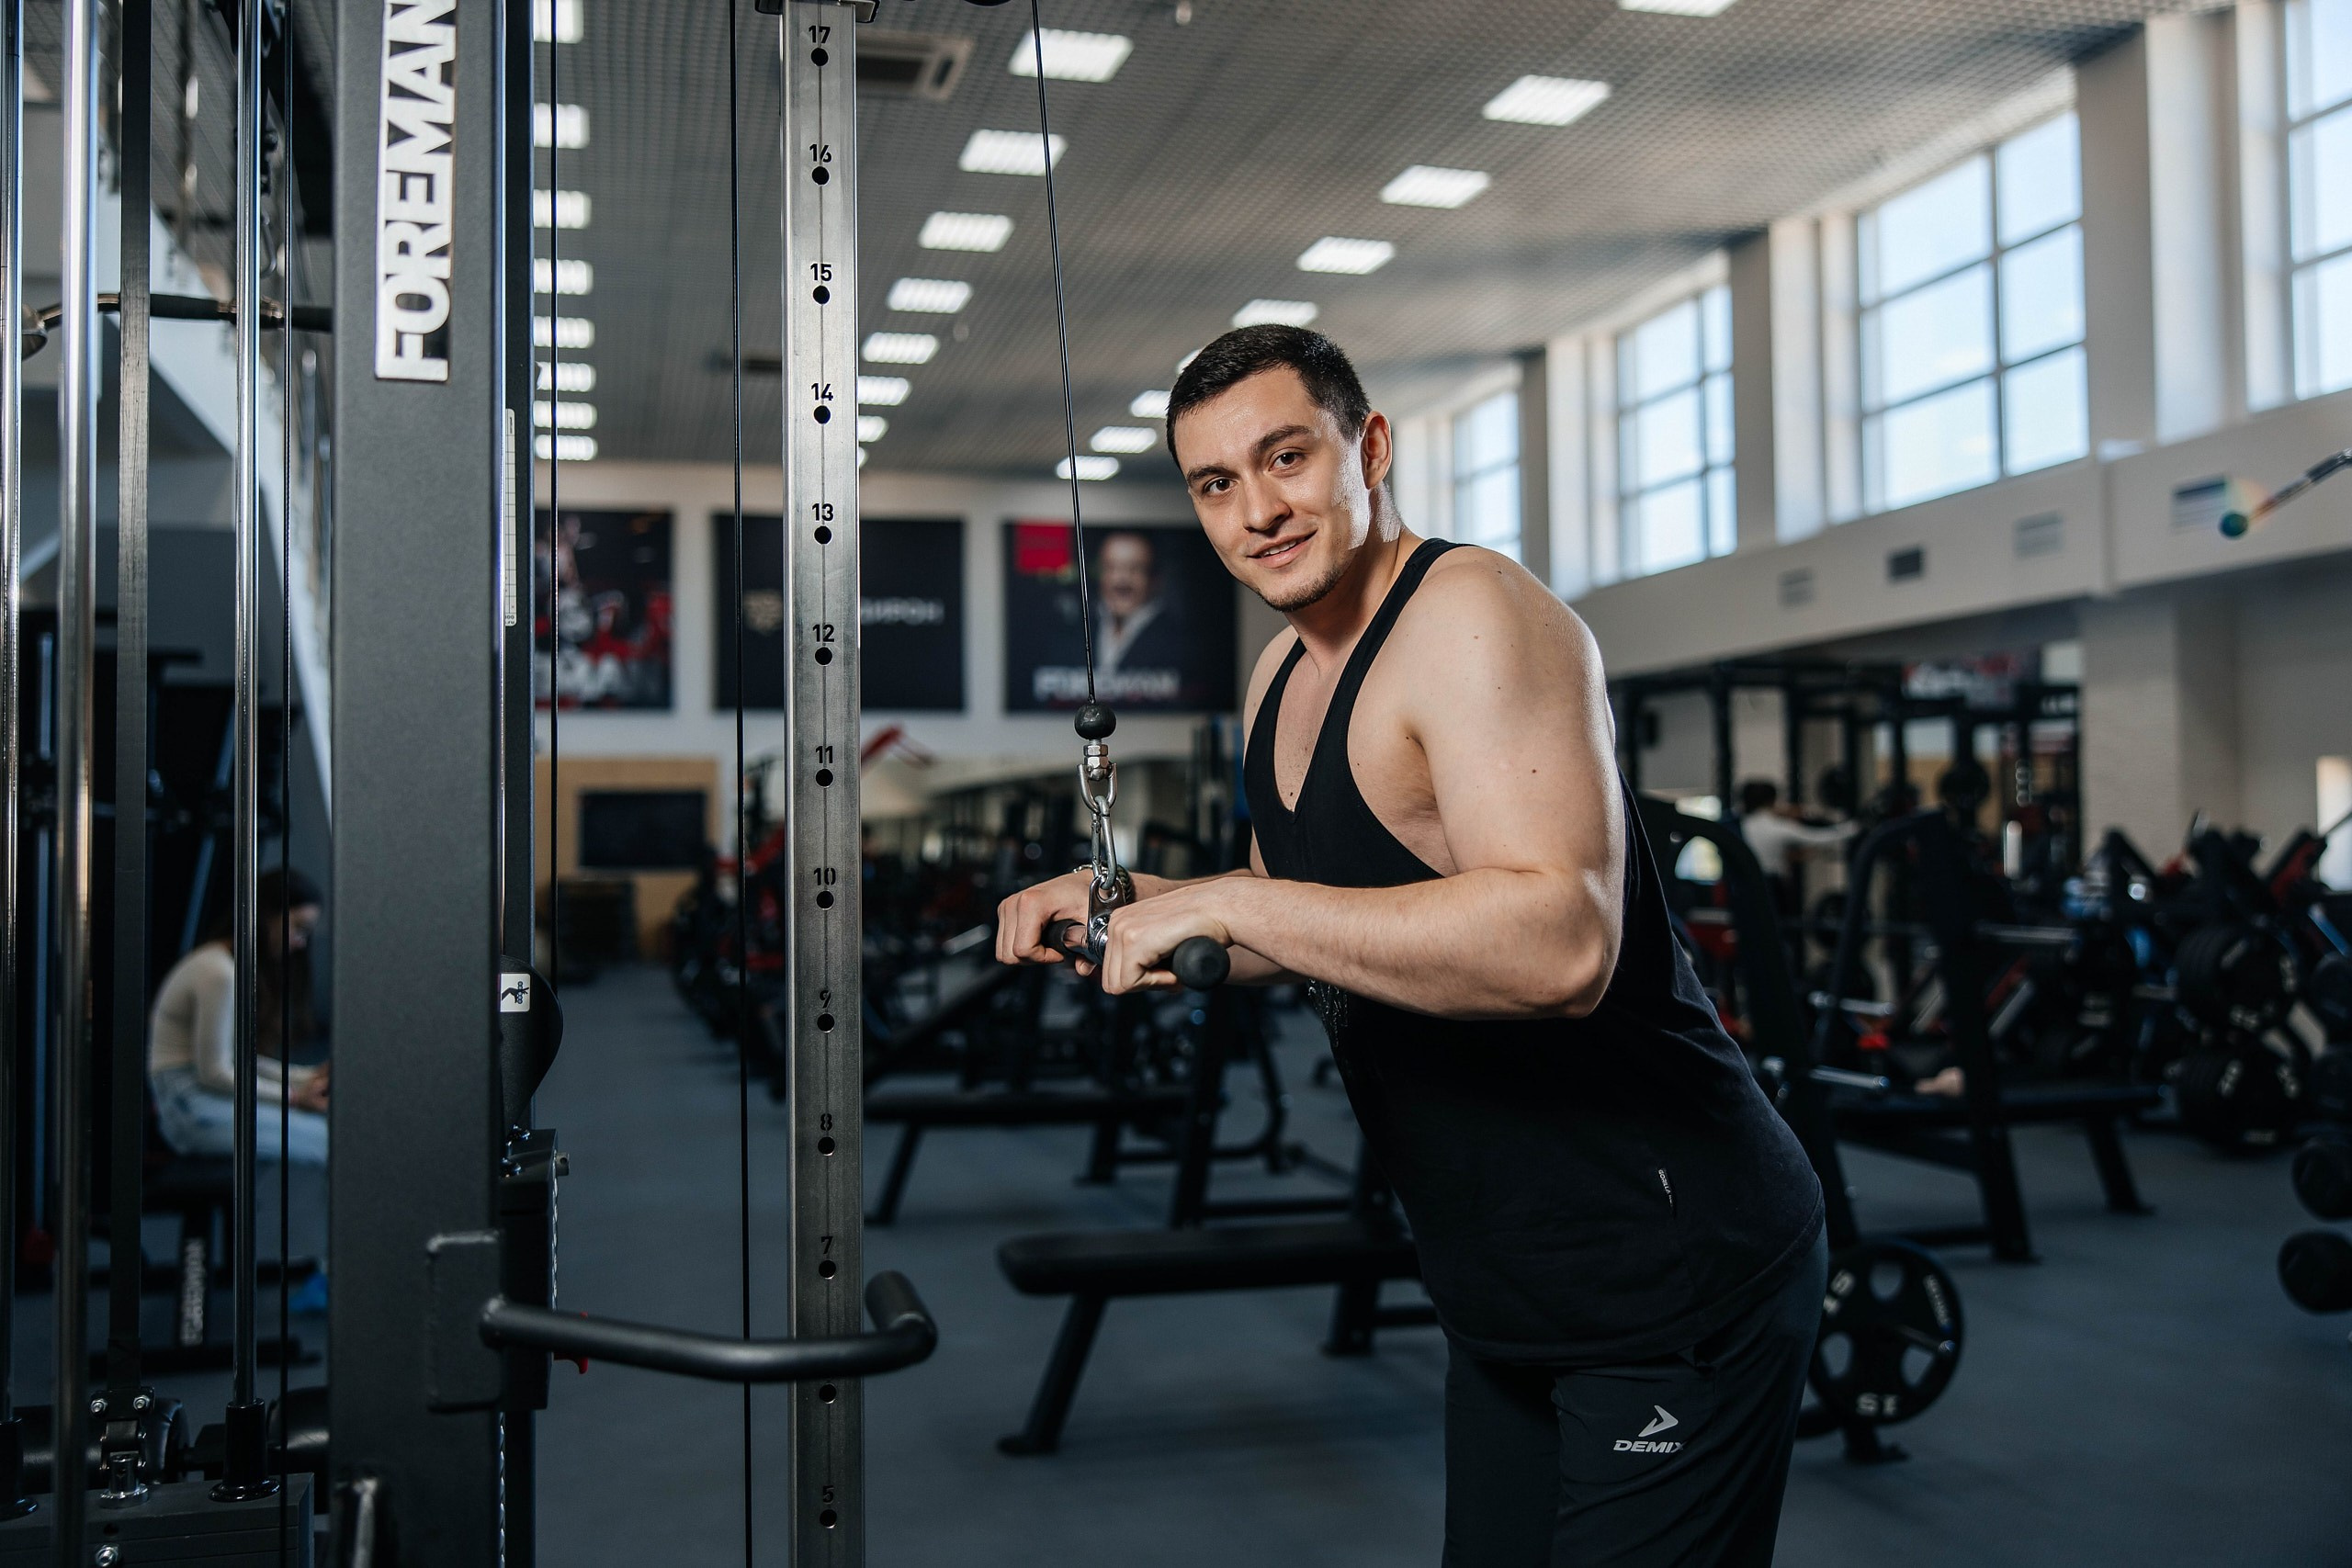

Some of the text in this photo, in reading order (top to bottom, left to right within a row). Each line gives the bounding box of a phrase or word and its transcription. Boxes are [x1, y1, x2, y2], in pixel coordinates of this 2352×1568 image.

[808, 26, 831, 44] 17
[809, 144, 832, 163] 16
[375, 0, 457, 382] FOREMAN
[810, 263, 832, 281] 15
[811, 383, 834, 400] 14
[812, 503, 834, 522] 13
[812, 624, 835, 642] 12
[815, 745, 834, 764] 11
[813, 867, 836, 886] 10
[819, 989, 831, 1010] 9
[820, 1112, 832, 1132] 8
[820, 1235, 833, 1255] 7
[1613, 1439, 1688, 1453] DEMIX
[822, 1484, 834, 1504] 5
